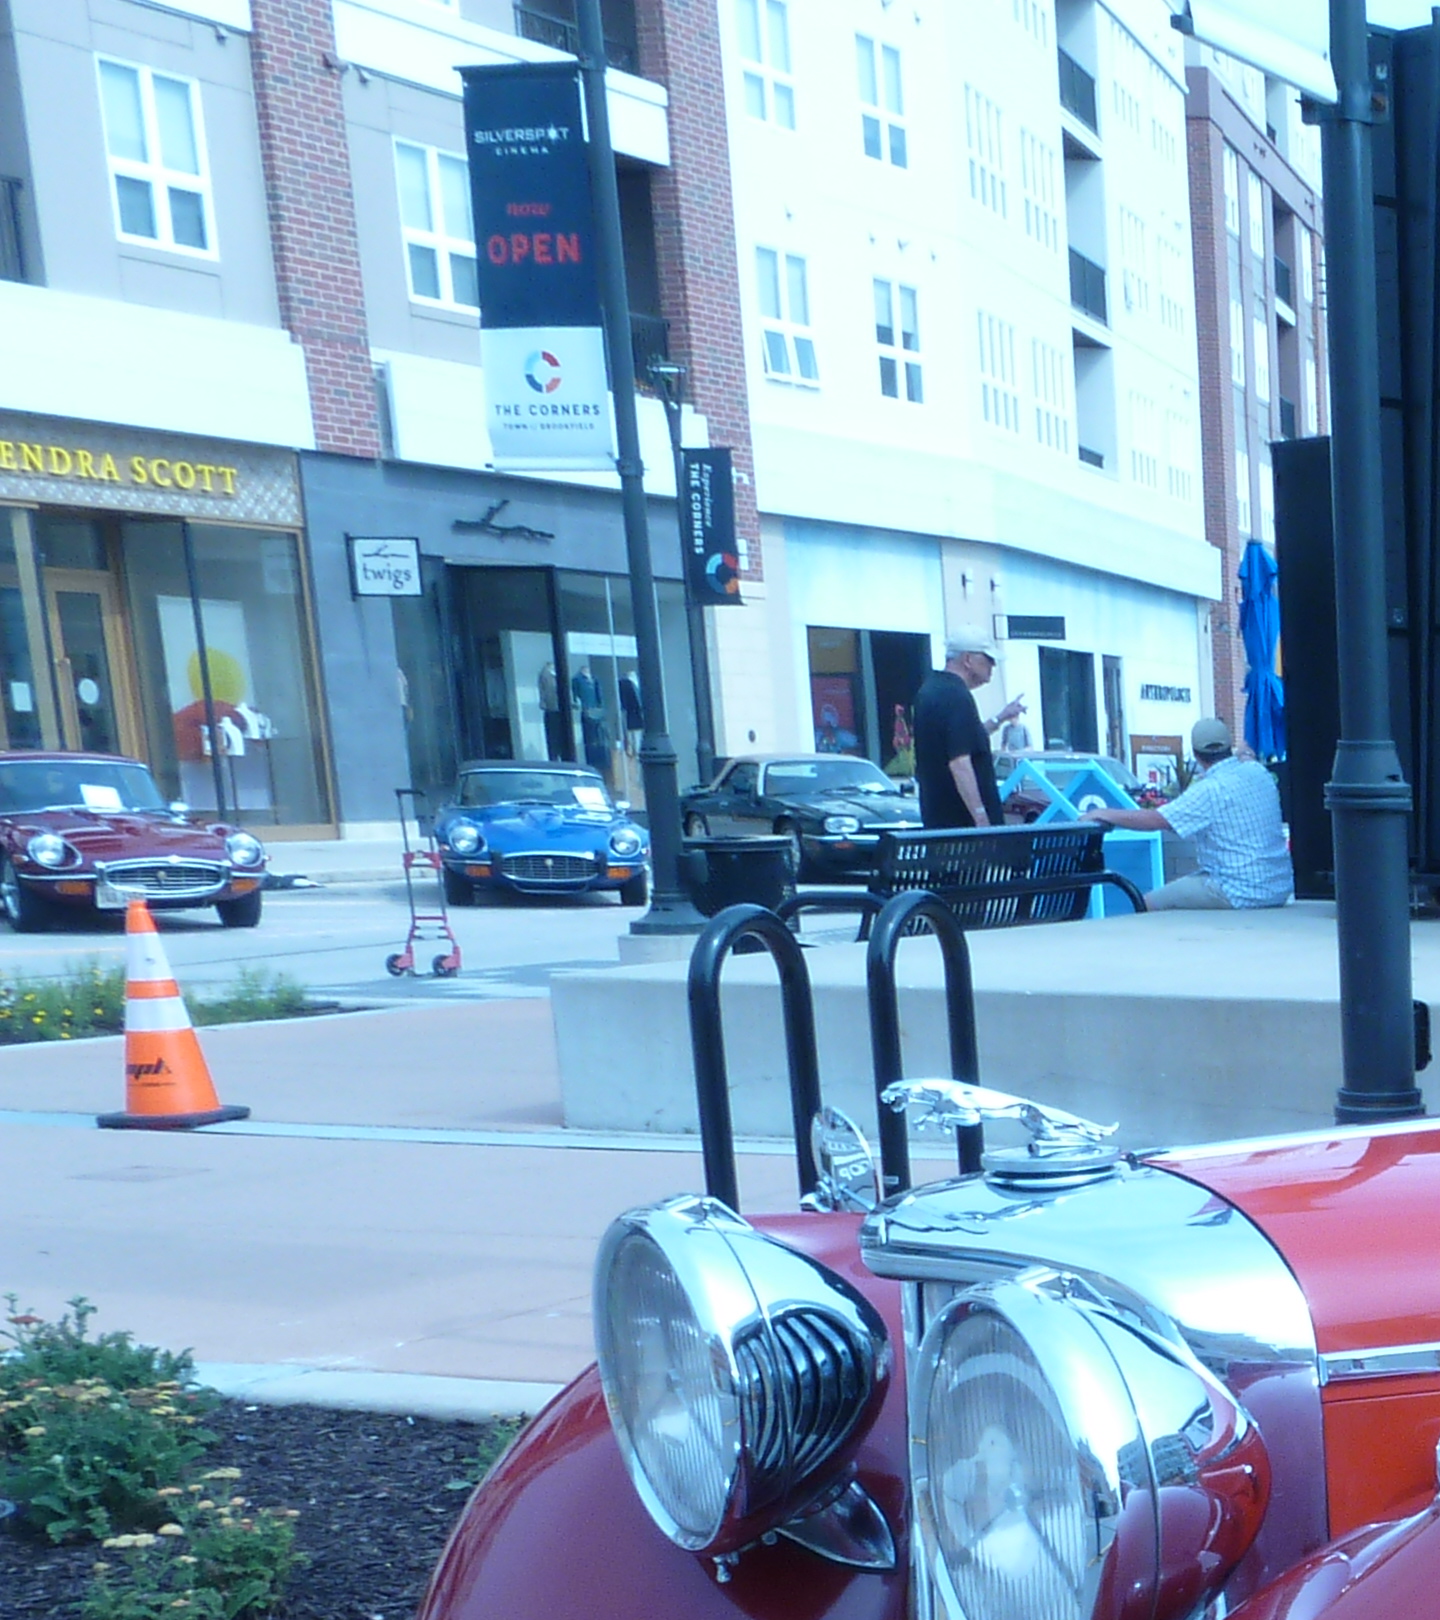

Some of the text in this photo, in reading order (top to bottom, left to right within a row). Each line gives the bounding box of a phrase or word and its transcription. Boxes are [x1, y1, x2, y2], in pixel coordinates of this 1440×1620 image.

[474, 125, 569, 144] SILVERSPOT
[495, 147, 550, 156] CINEMA
[488, 232, 581, 265] OPEN
[495, 404, 600, 416] THE CORNERS
[130, 455, 238, 494] SCOTT
[690, 463, 705, 555] THE CORNERS
[363, 563, 412, 589] twigs
